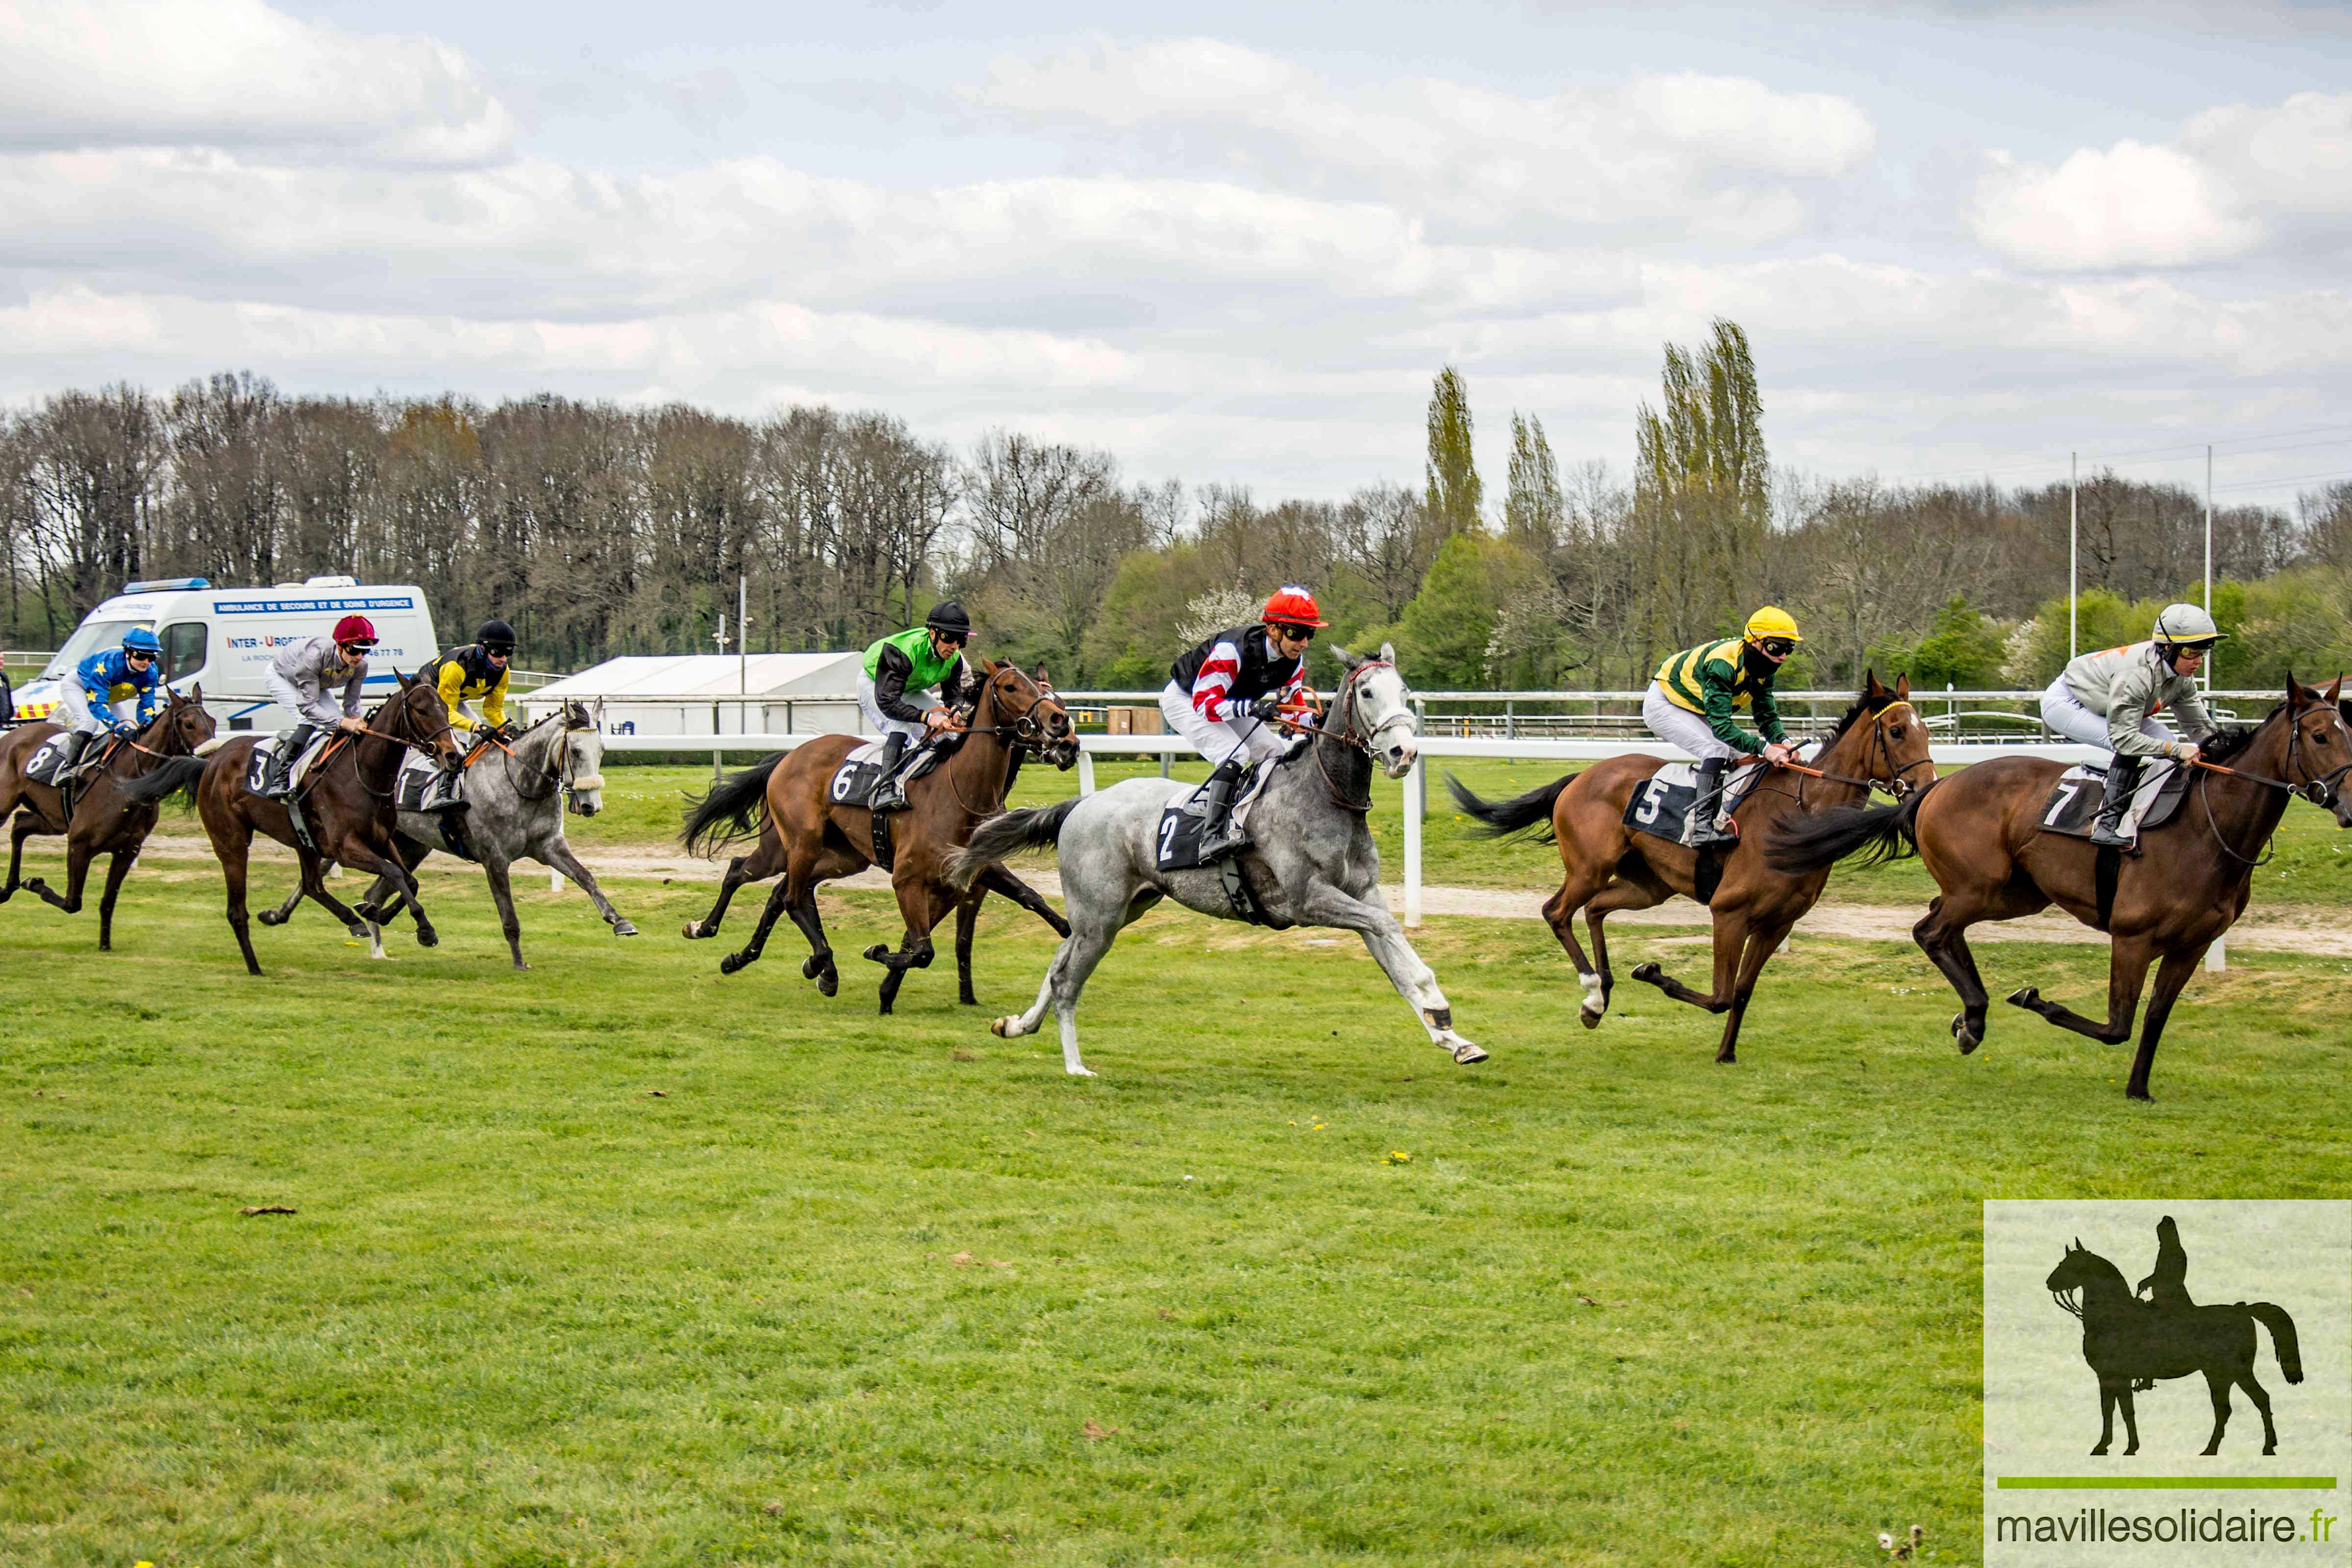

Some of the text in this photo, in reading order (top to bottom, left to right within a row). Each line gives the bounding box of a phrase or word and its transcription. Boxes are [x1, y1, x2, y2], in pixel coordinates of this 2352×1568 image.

[26, 747, 52, 774] 8
[250, 755, 268, 790] 3
[398, 772, 410, 803] 1
[833, 764, 857, 800] 6
[1636, 779, 1669, 824] 5
[2043, 783, 2079, 826] 7
[1160, 815, 1177, 861] 2
